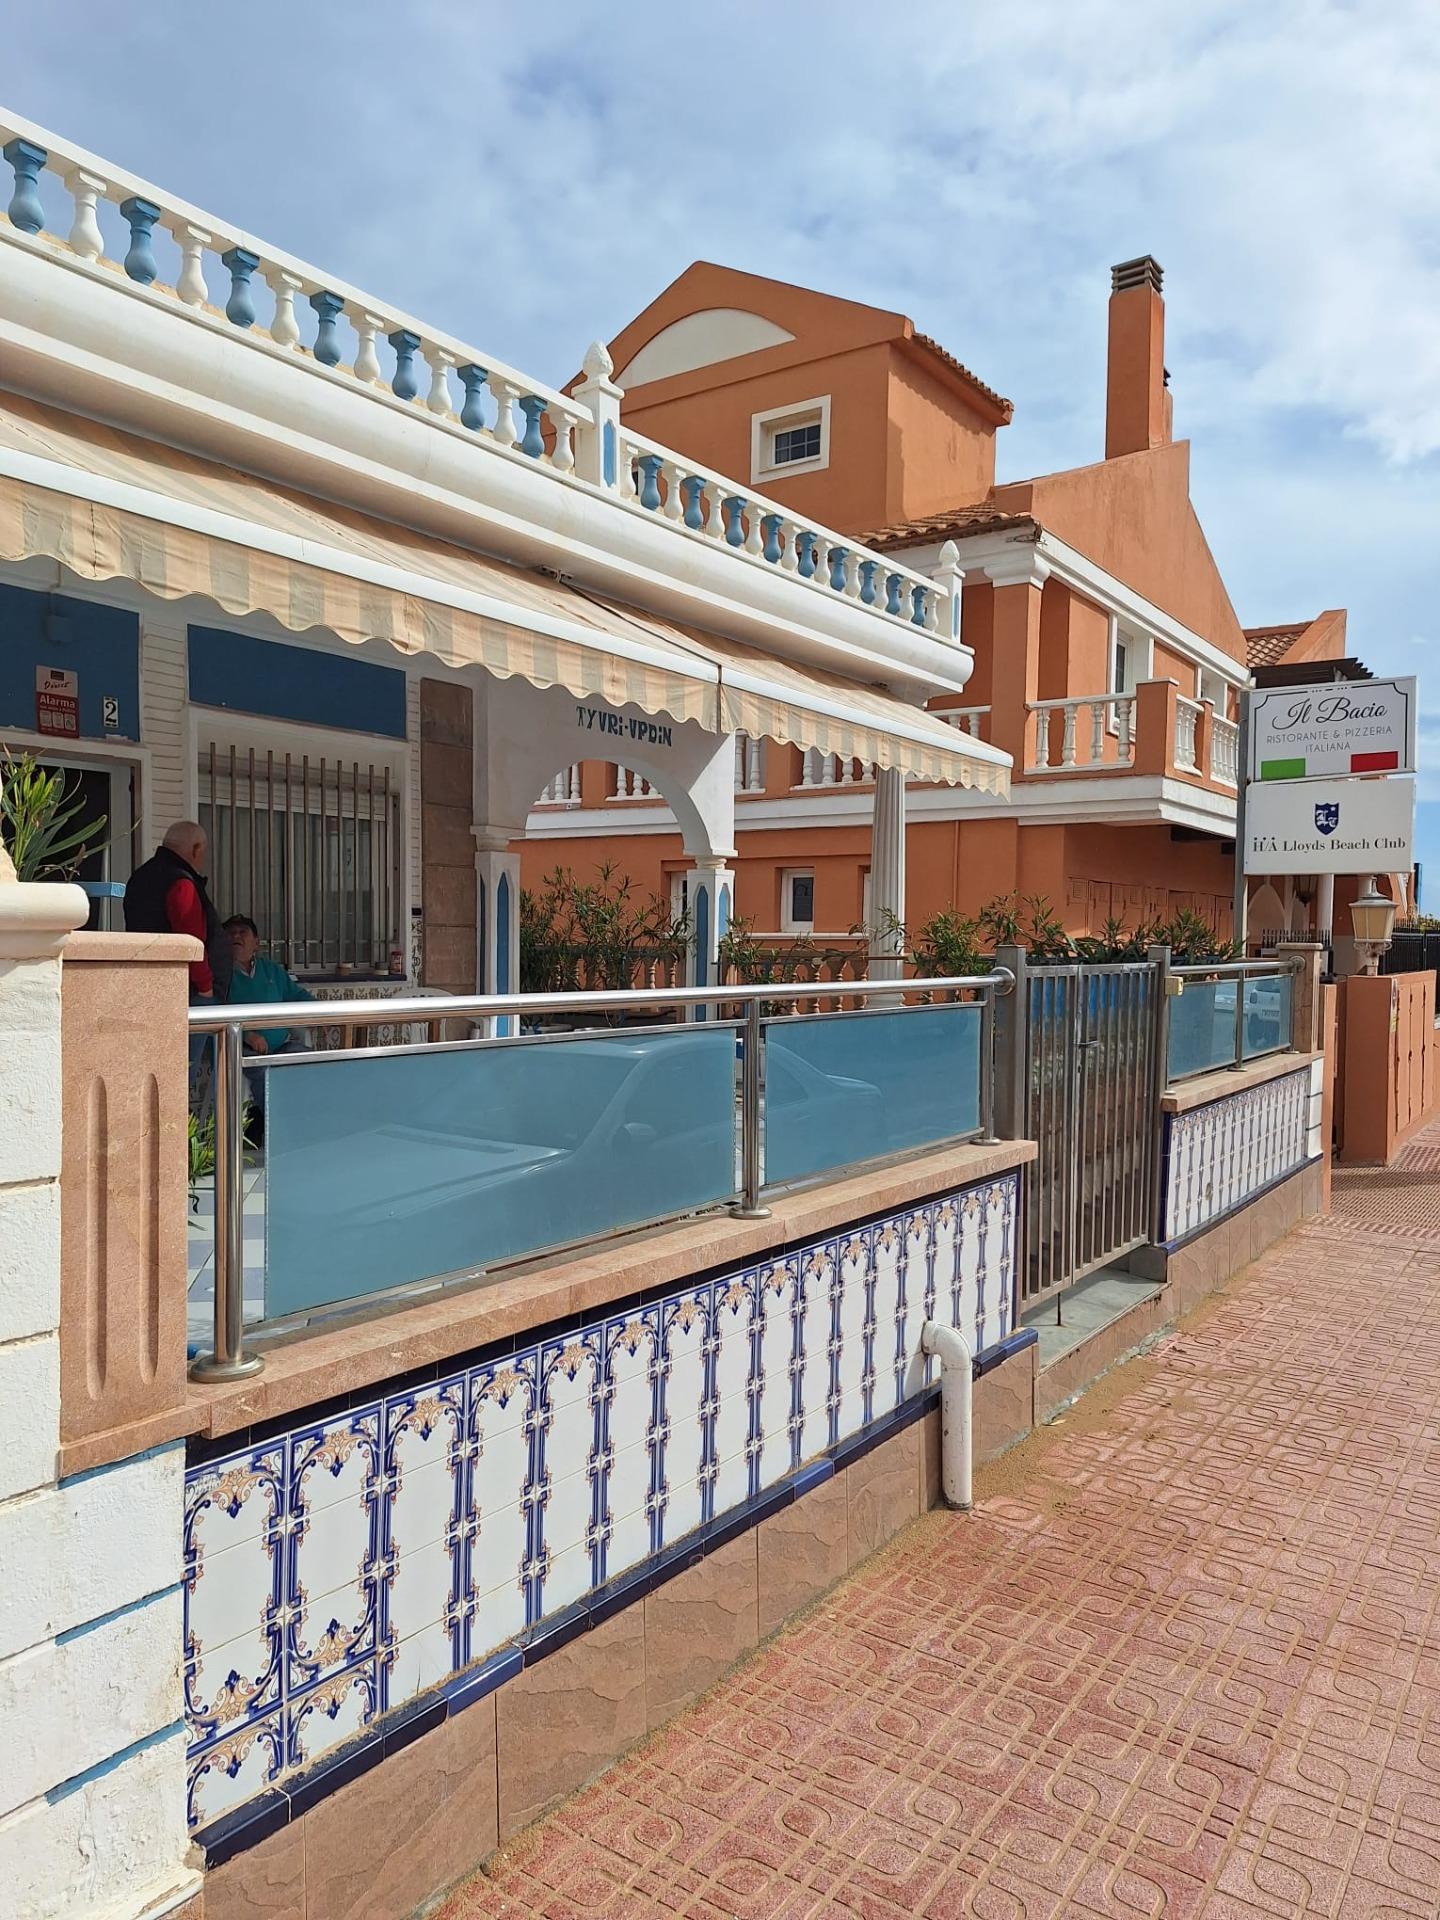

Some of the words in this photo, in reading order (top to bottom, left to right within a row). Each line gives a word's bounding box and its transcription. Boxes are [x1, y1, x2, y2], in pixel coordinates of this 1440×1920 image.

[39, 694, 76, 709] Alarma
[105, 701, 117, 723] 2
[1272, 698, 1311, 730] Il
[1315, 696, 1388, 724] Bacio
[1266, 730, 1328, 744] RISTORANTE
[1333, 729, 1341, 739] &
[1345, 725, 1393, 737] PIZZERIA
[1305, 741, 1351, 753] ITALIANA
[1284, 838, 1326, 854] Lloyds
[1330, 837, 1370, 850] Beach
[1374, 836, 1406, 849] Club
